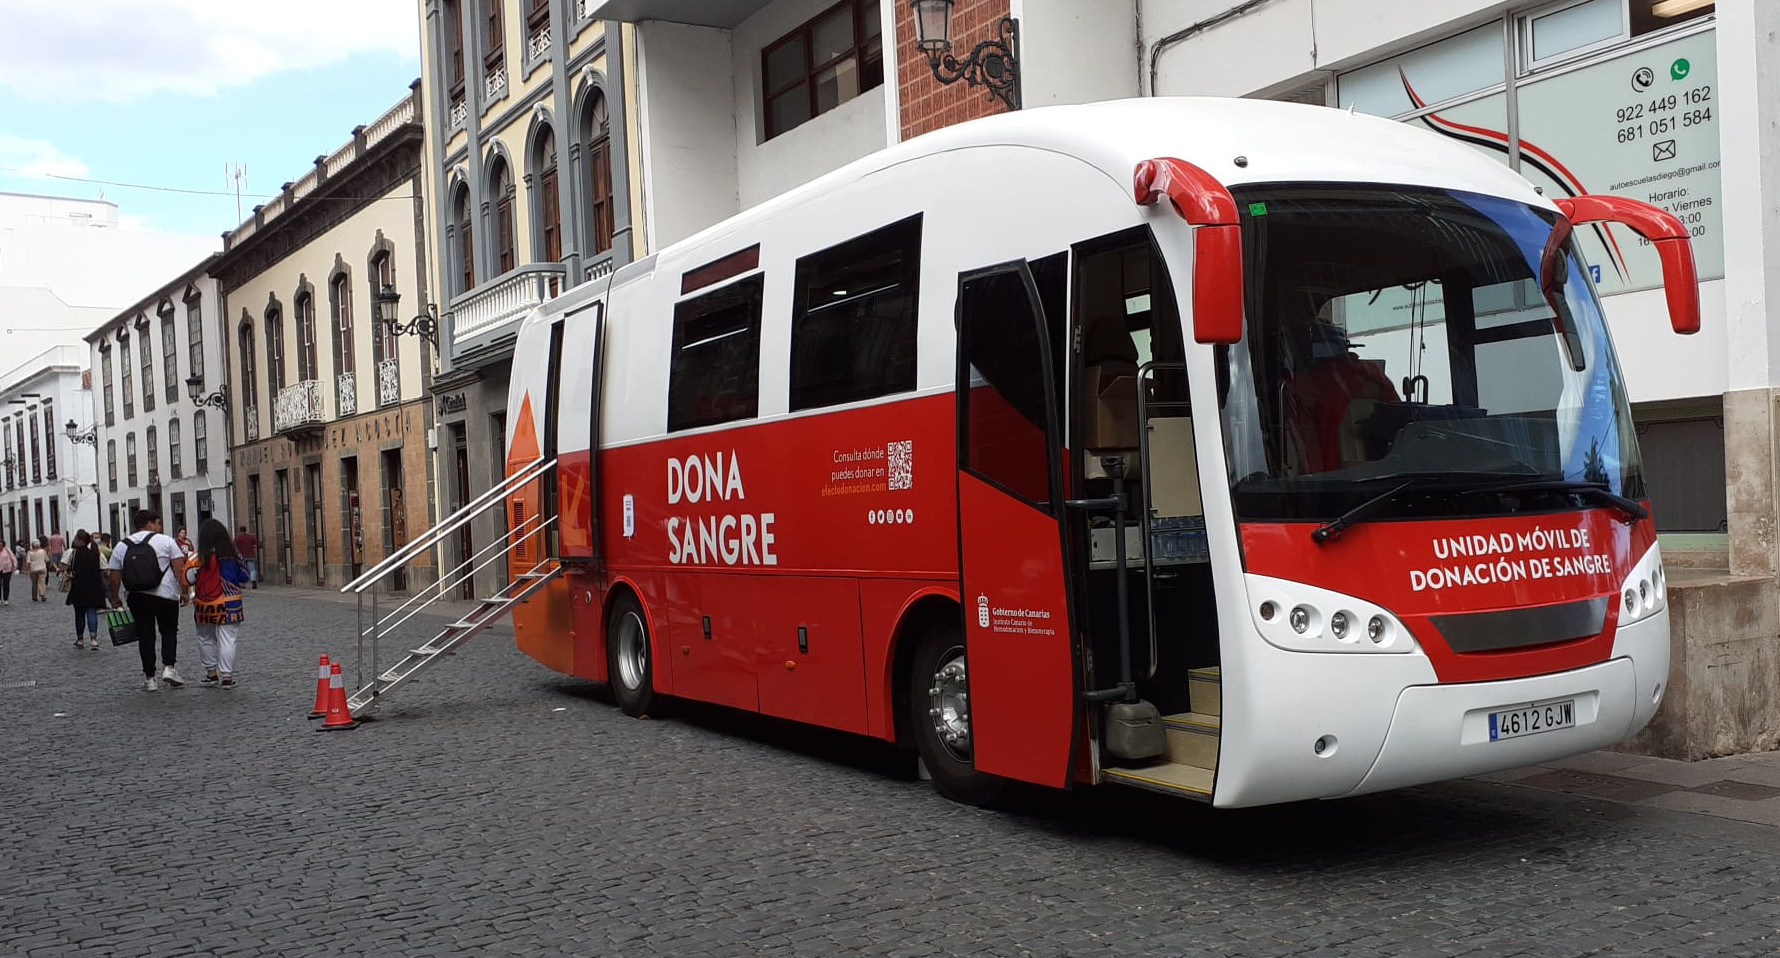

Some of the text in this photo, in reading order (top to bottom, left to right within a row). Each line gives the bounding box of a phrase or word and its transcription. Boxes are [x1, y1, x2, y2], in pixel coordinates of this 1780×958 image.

[1616, 86, 1711, 123] 922 449 162
[1617, 107, 1712, 143] 681 051 584
[1648, 187, 1690, 203] Horario:
[1672, 197, 1713, 212] Viernes
[833, 448, 862, 463] Consulta
[667, 447, 745, 504] DONA
[831, 465, 885, 483] puedes donar en
[667, 513, 778, 565] SANGRE
[1432, 525, 1591, 560] UNIDAD MÓVIL DE
[1410, 554, 1611, 591] DONACIÓN DE SANGRE
[992, 607, 1051, 619] Gobierno de Canarias
[1501, 709, 1540, 735] 4612
[1545, 703, 1572, 727] GJW
